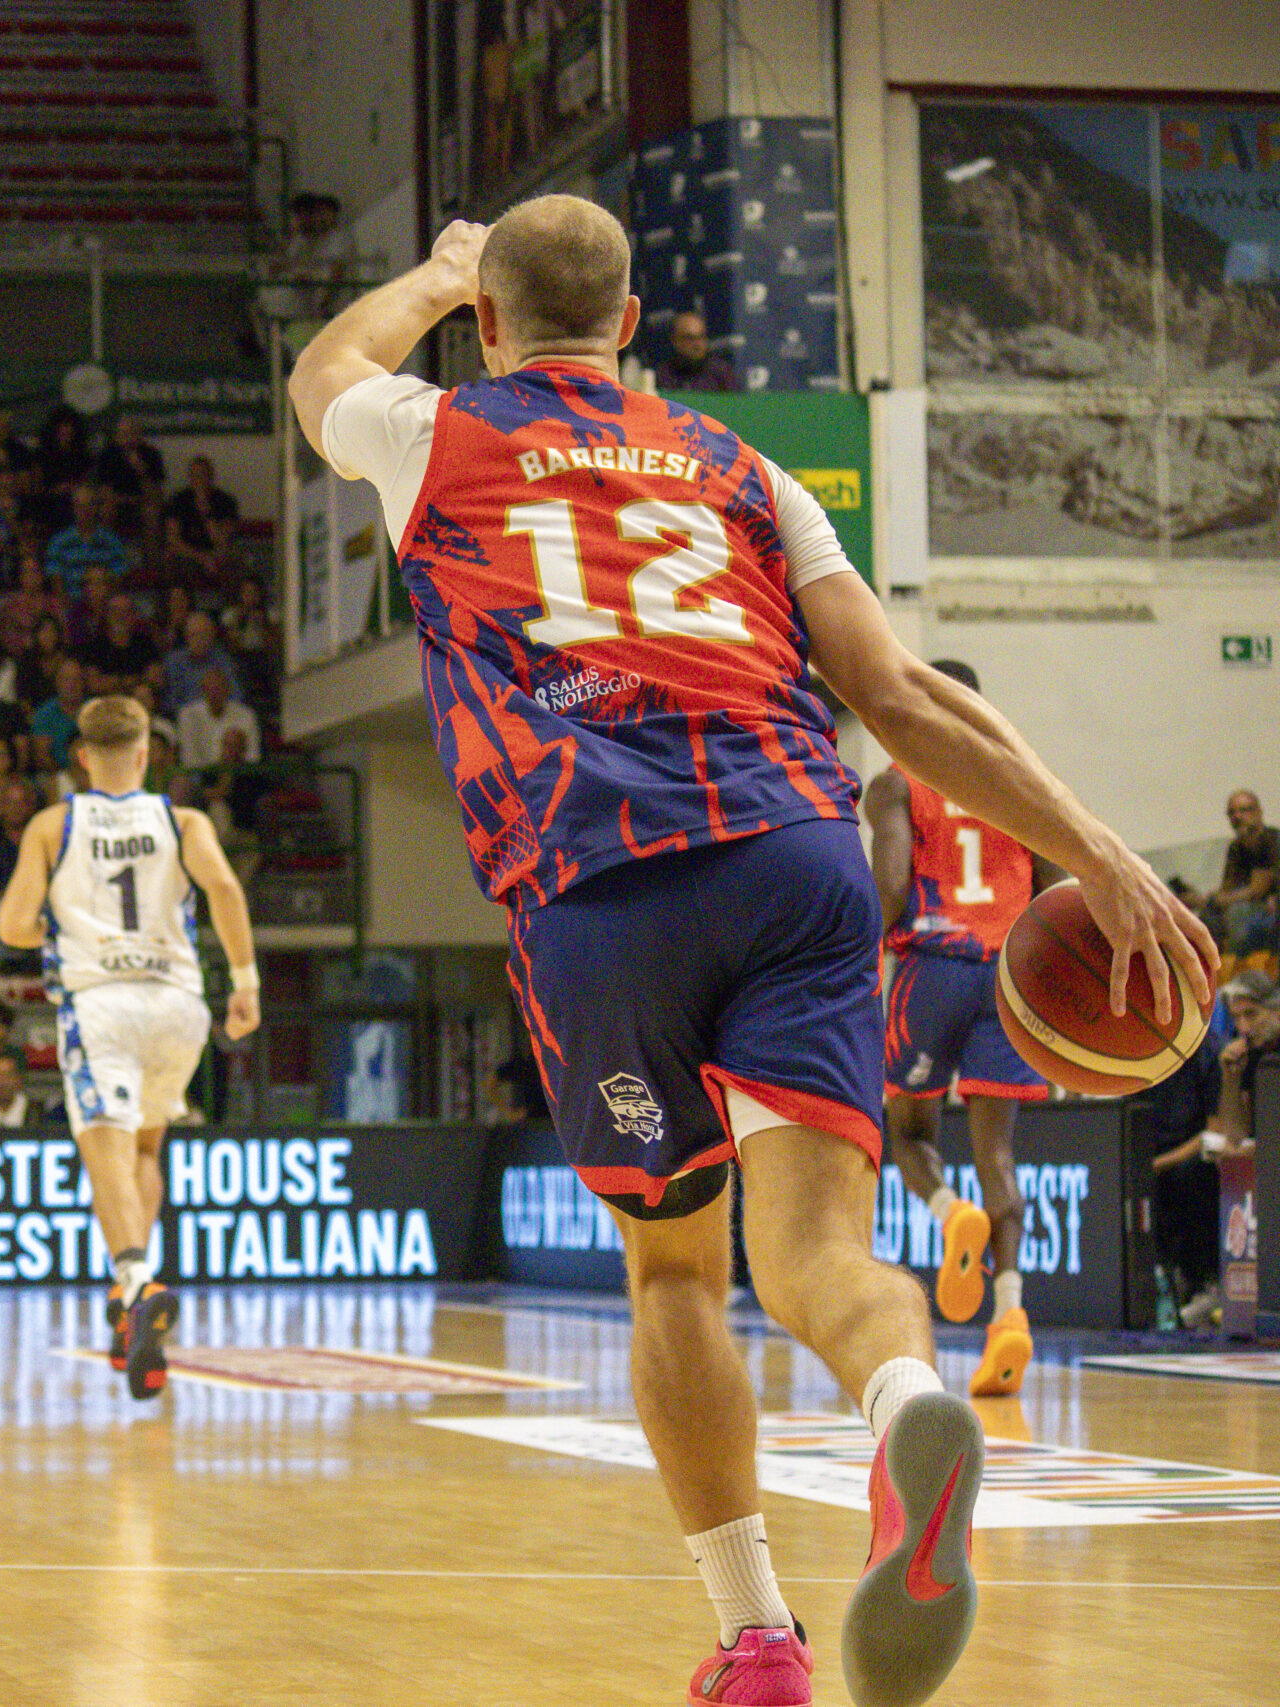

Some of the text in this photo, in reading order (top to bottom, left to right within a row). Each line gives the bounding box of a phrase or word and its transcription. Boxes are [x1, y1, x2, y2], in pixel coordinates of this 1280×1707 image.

[516, 446, 703, 484] BARGNESI
[503, 497, 755, 648] 12
[549, 666, 600, 696] SALUS
[550, 673, 641, 712] NOLEGGIO
[92, 835, 157, 860] FLOOD
[954, 827, 995, 904] 1
[108, 863, 140, 932] 1
[610, 1084, 645, 1094] Garage
[623, 1121, 639, 1129] Via
[169, 1137, 353, 1207] HOUSE
[178, 1207, 439, 1279] ITALIANA
